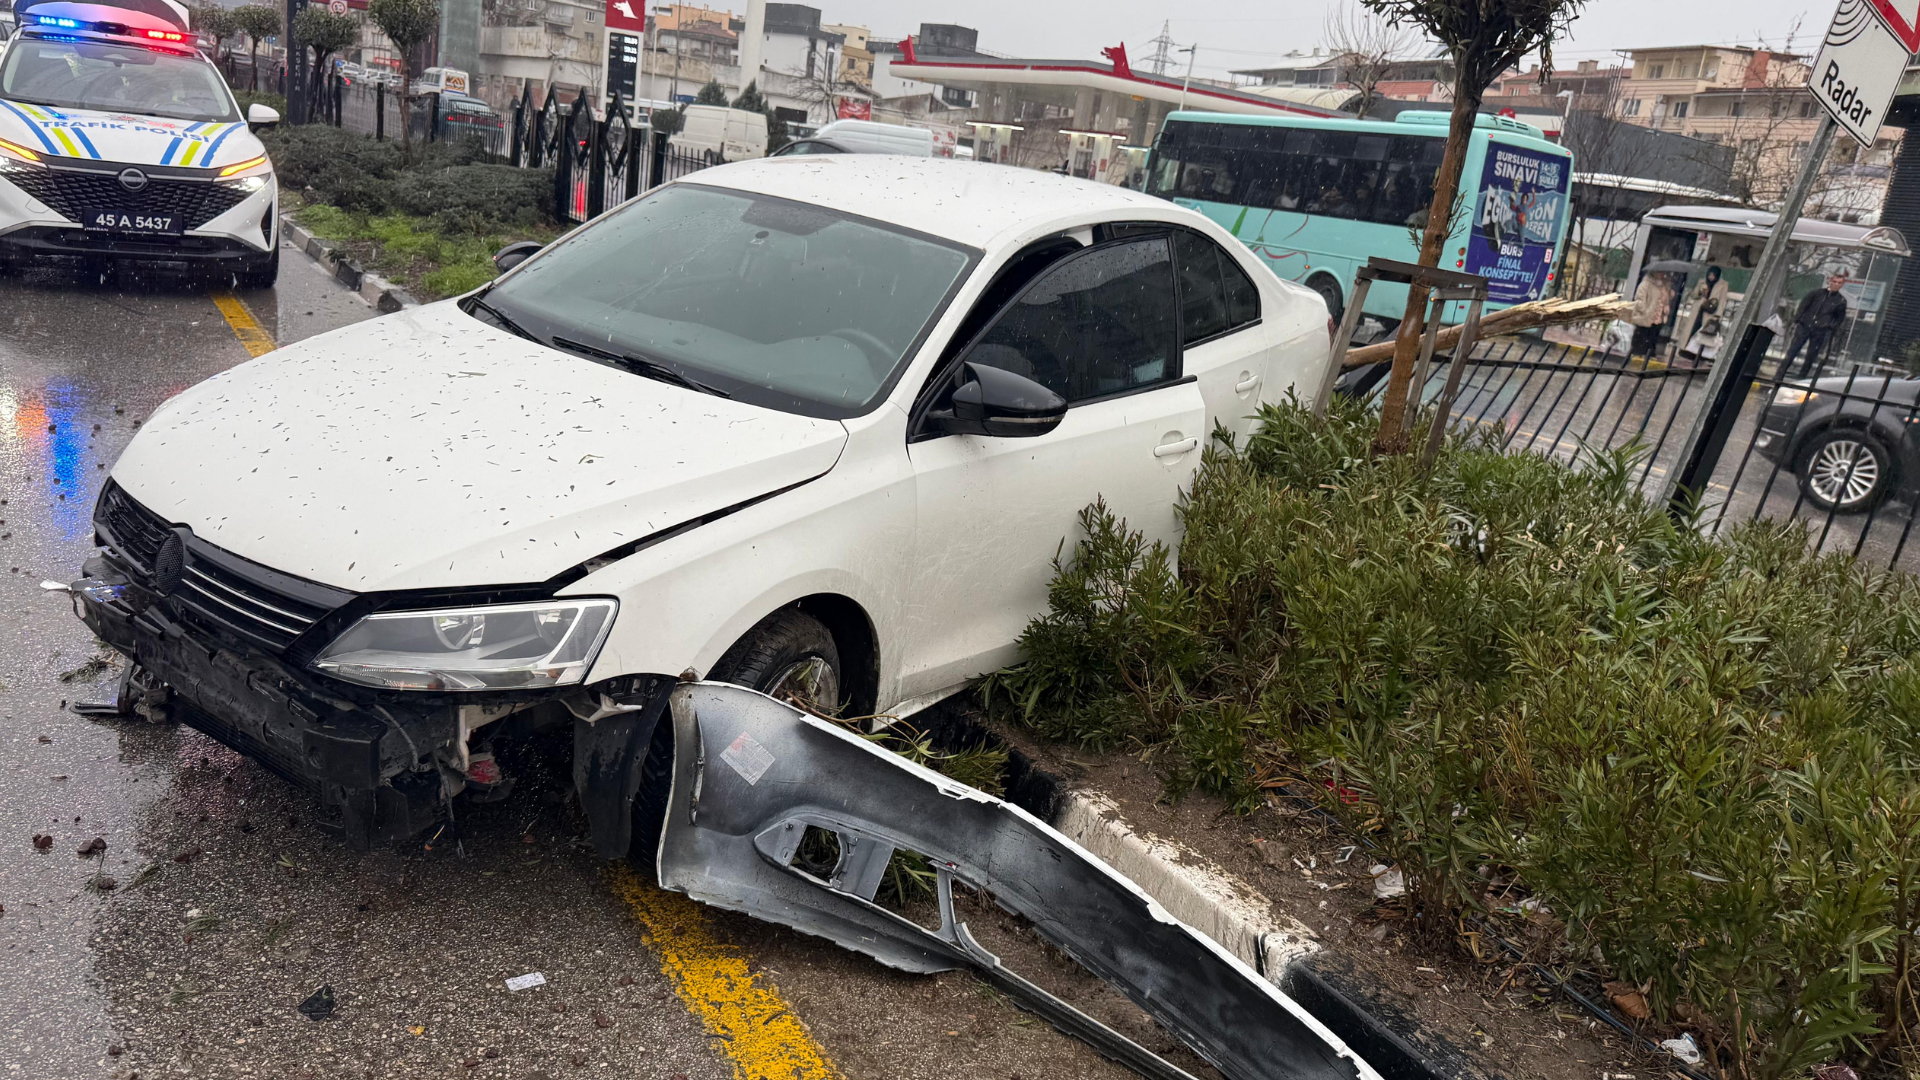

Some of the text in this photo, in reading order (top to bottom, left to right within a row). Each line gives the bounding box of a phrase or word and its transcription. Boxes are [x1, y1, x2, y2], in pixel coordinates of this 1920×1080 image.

[1821, 59, 1872, 127] Radar
[39, 121, 128, 130] TRAFİK
[1496, 150, 1540, 169] BURSLULUK
[1494, 161, 1539, 184] SINAVI
[1530, 197, 1557, 220] YÖN
[96, 213, 171, 229] 45 A 5437
[1500, 244, 1523, 257] BURS
[1497, 256, 1522, 270] FİNAL
[1479, 265, 1534, 283] KONSEPT'TE!
